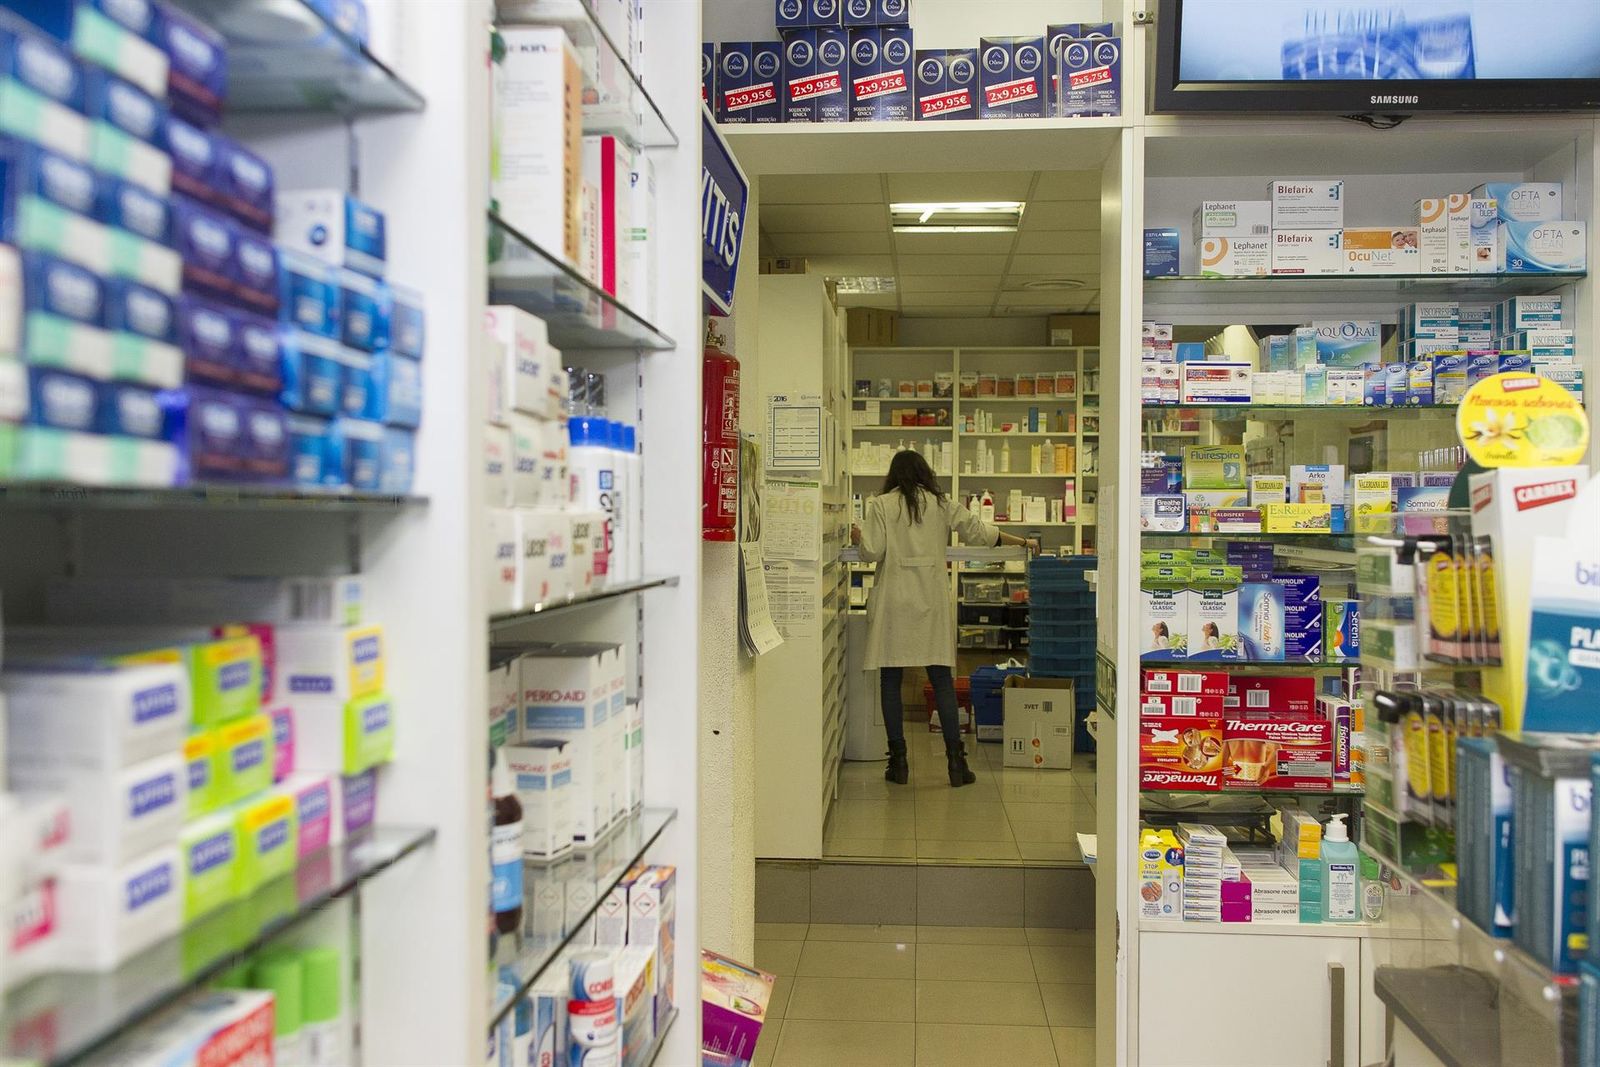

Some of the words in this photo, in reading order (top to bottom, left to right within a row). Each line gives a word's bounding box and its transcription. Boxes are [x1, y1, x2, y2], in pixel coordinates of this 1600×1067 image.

[1073, 71, 1108, 85] 2x5,75€
[793, 78, 838, 95] 2x9,95€
[858, 77, 903, 95] 2x9,95€
[729, 89, 772, 106] 2x9,95€
[989, 84, 1033, 101] 2x9,95€
[924, 95, 967, 112] 2x9,95€
[1370, 95, 1419, 105] SAMSUNG
[1278, 185, 1314, 194] Blefarix
[1511, 190, 1540, 200] OFTA
[1205, 203, 1236, 211] Lephanet
[1277, 234, 1313, 243] Blefarix
[1532, 229, 1564, 240] OFTA
[1233, 242, 1268, 251] Lephanet
[1349, 251, 1392, 261] OcuNet
[1512, 259, 1523, 267] 30
[1316, 322, 1378, 339] AQUORAL
[1191, 450, 1240, 462] Fluirespiro
[1406, 499, 1436, 508] Somnio
[1263, 592, 1271, 621] Somnio
[1351, 611, 1360, 648] Serenia
[1263, 641, 1271, 652] 1.9
[1226, 720, 1324, 732] ThermaCare
[1339, 725, 1349, 766] fisiocrem
[1143, 774, 1218, 786] ThermaCare
